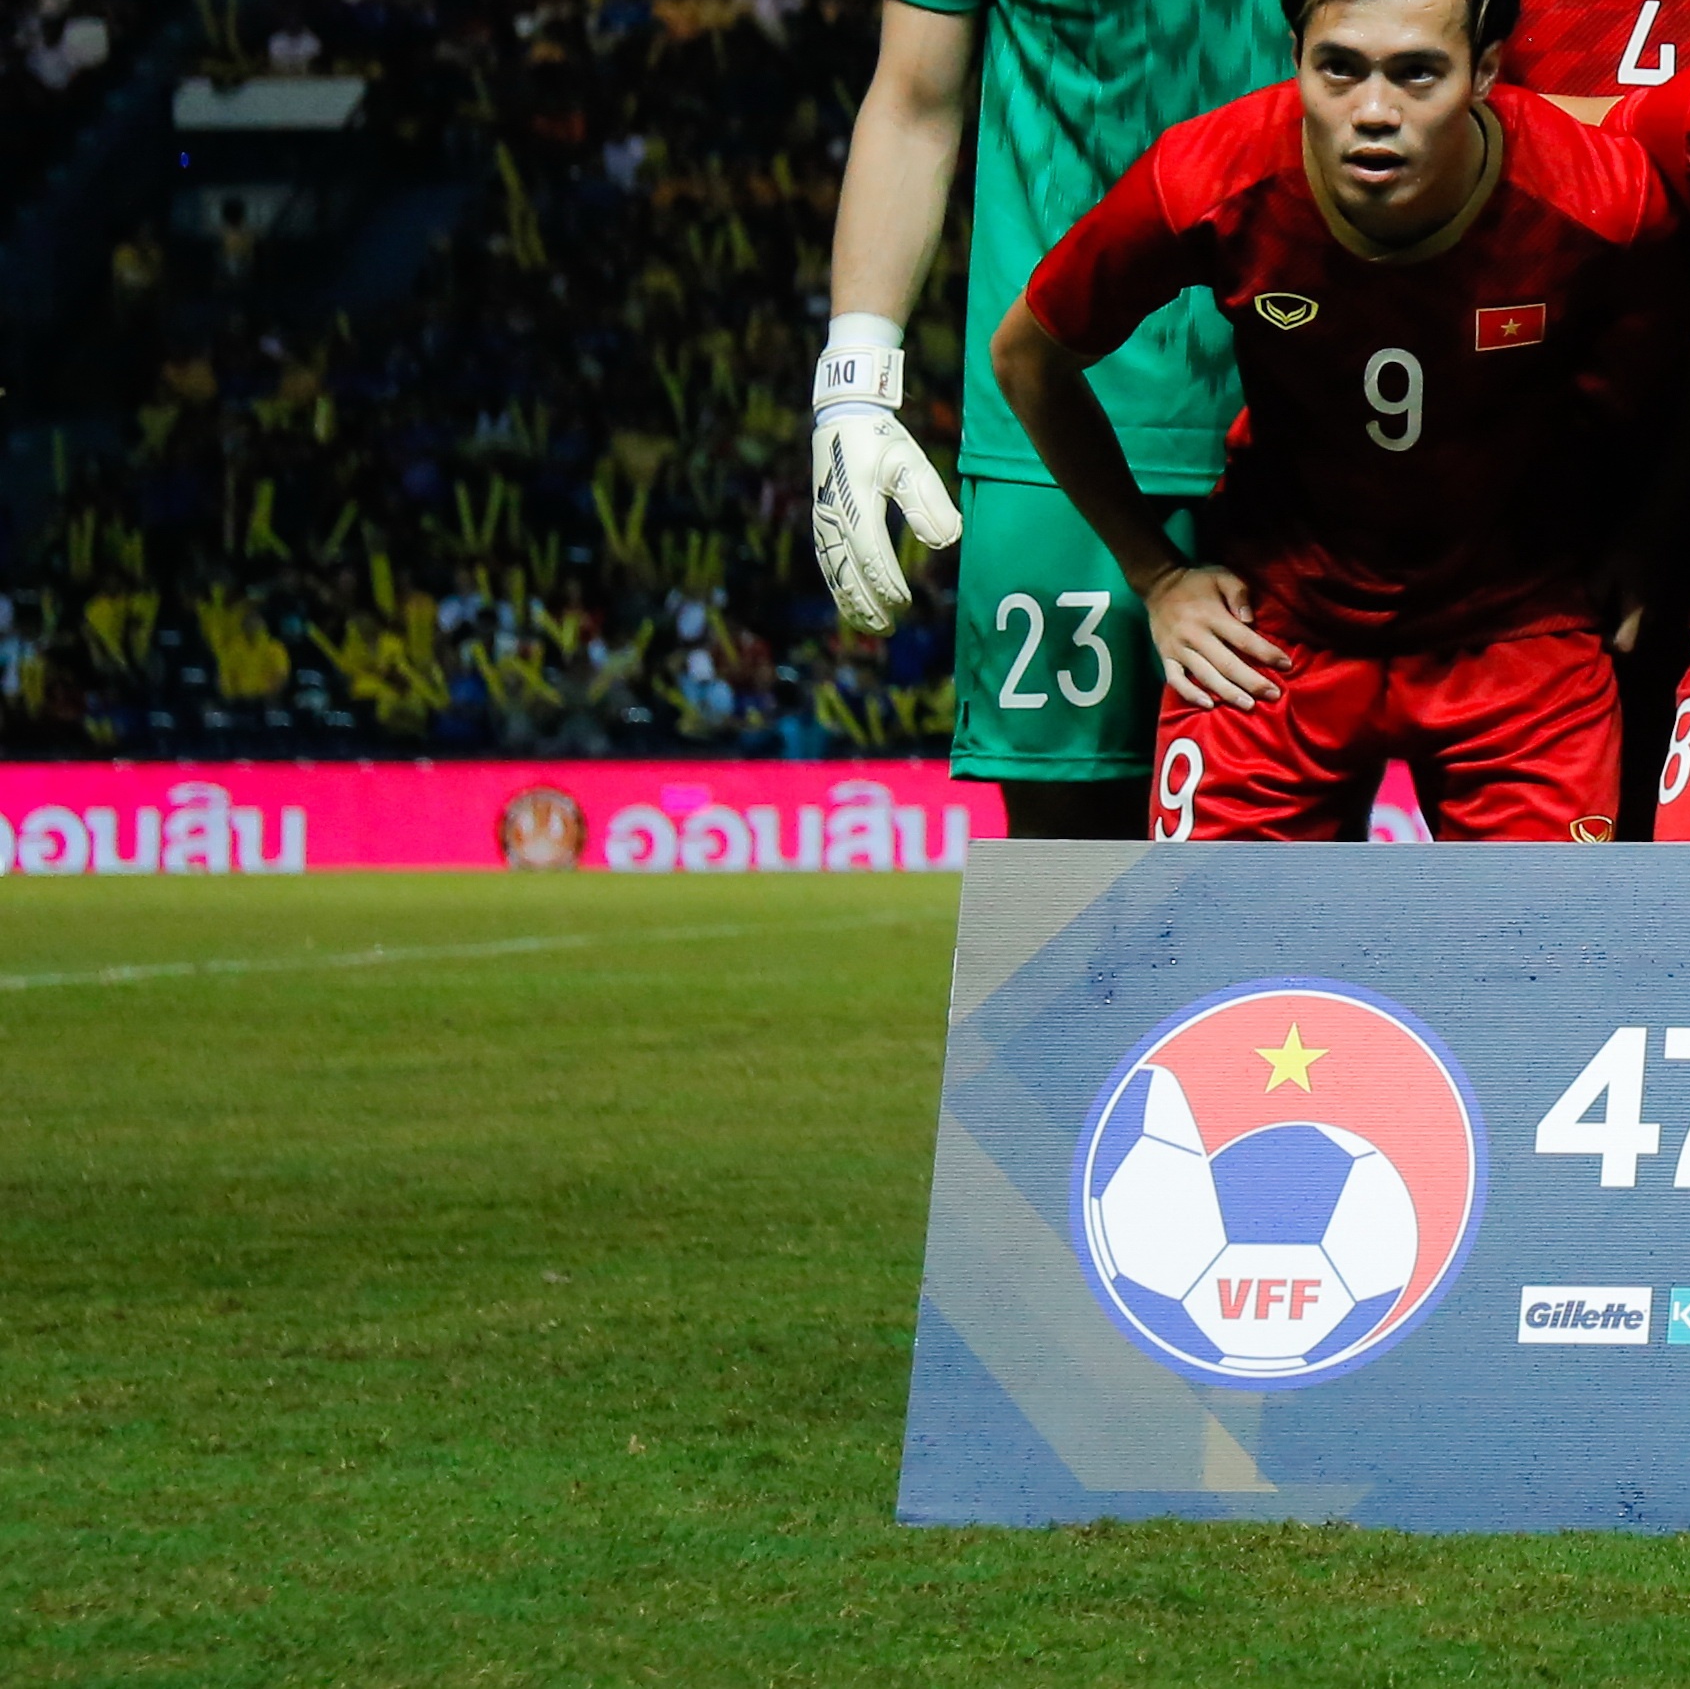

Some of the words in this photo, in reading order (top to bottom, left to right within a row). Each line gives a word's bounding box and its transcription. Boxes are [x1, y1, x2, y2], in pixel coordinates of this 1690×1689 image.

[1616, 0, 1676, 87] 4
[826, 359, 856, 388] DVL
[1363, 347, 1424, 452] 9
[995, 590, 1114, 710] 23
[0, 780, 306, 875] อมสิน
[605, 780, 970, 873] ออมสิน
[1154, 737, 1204, 842] 9
[1217, 1278, 1322, 1320] VFF
[1525, 1300, 1646, 1330] Gillette
